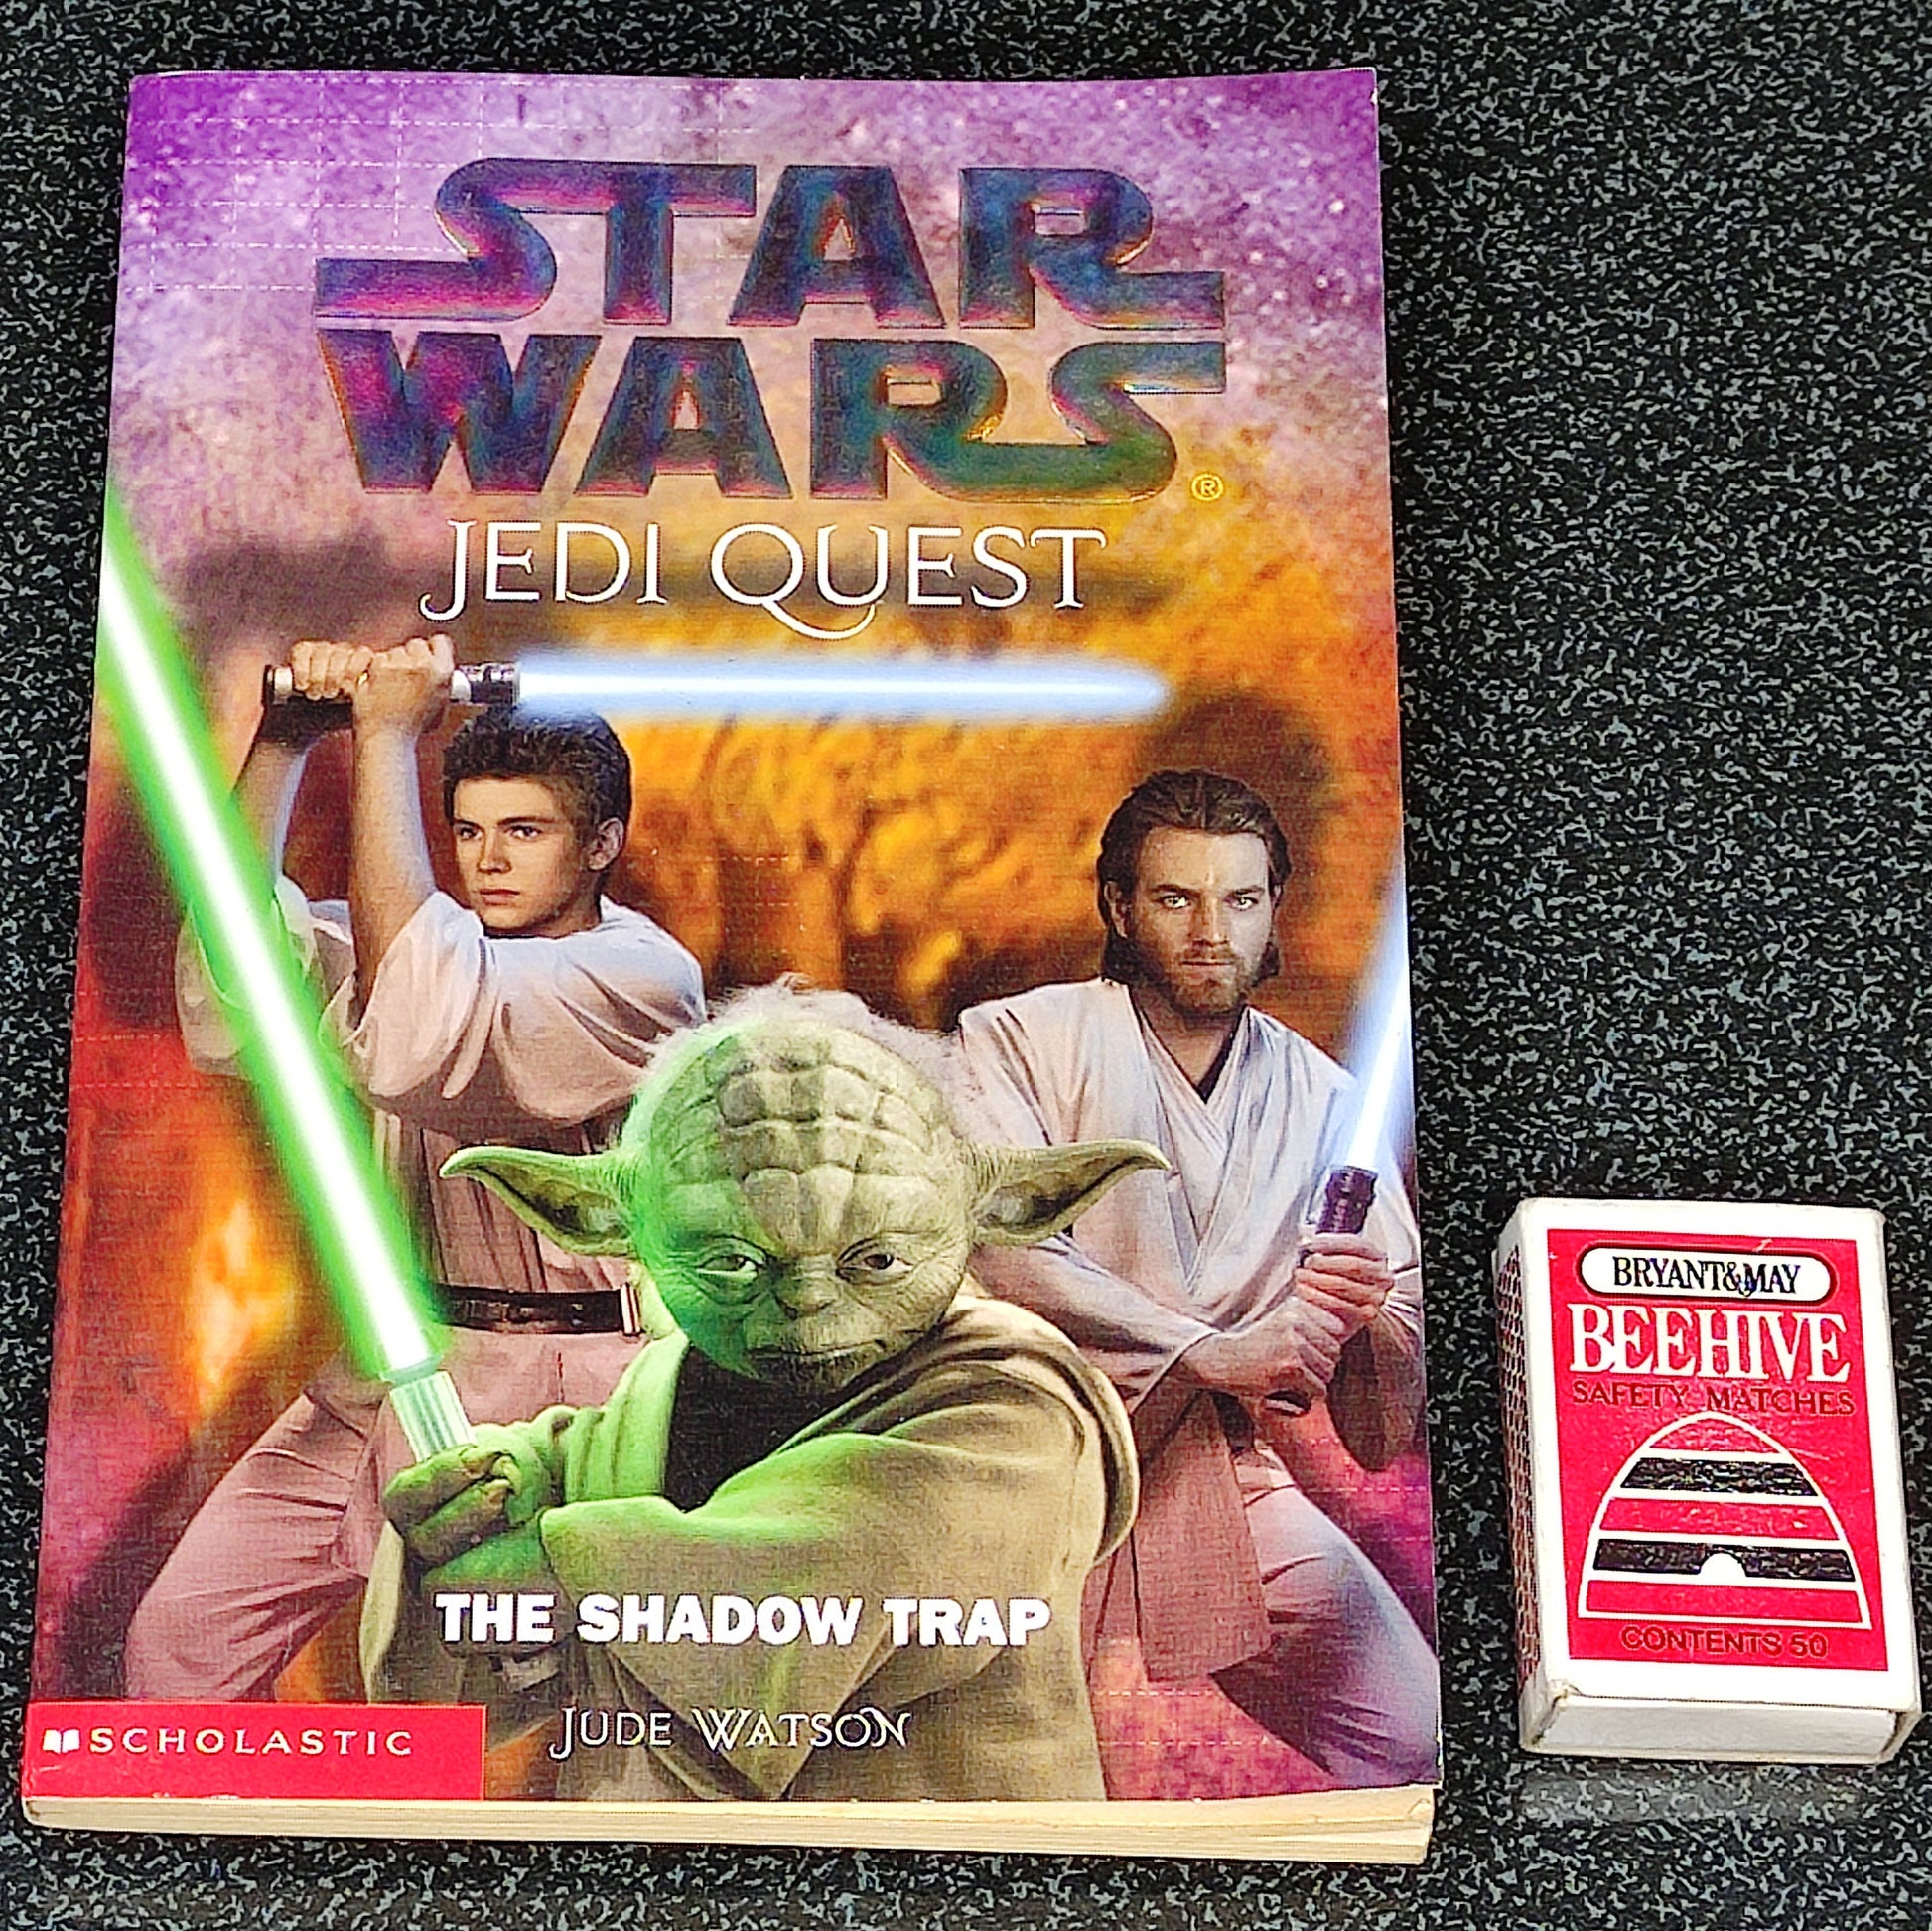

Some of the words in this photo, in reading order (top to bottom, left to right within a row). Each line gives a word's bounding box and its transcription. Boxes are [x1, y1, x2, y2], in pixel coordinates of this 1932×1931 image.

[314, 157, 1227, 330] STAR
[316, 330, 1227, 504] WARS
[419, 518, 668, 621] JEDI
[709, 522, 1108, 640] QUEST
[1569, 1303, 1852, 1383] BEEHIVE
[1572, 1379, 1687, 1408] SAFETY
[1706, 1386, 1855, 1416] MATCHES
[435, 1592, 556, 1642] THE
[576, 1595, 866, 1646] SHADOW
[882, 1596, 1050, 1648] TRAP
[1620, 1626, 1784, 1656] CONTENTS
[1790, 1632, 1829, 1657] 50
[89, 1725, 413, 1757] SCHOLASTIC
[548, 1705, 672, 1760] JUDE
[691, 1706, 911, 1750] WATSON
